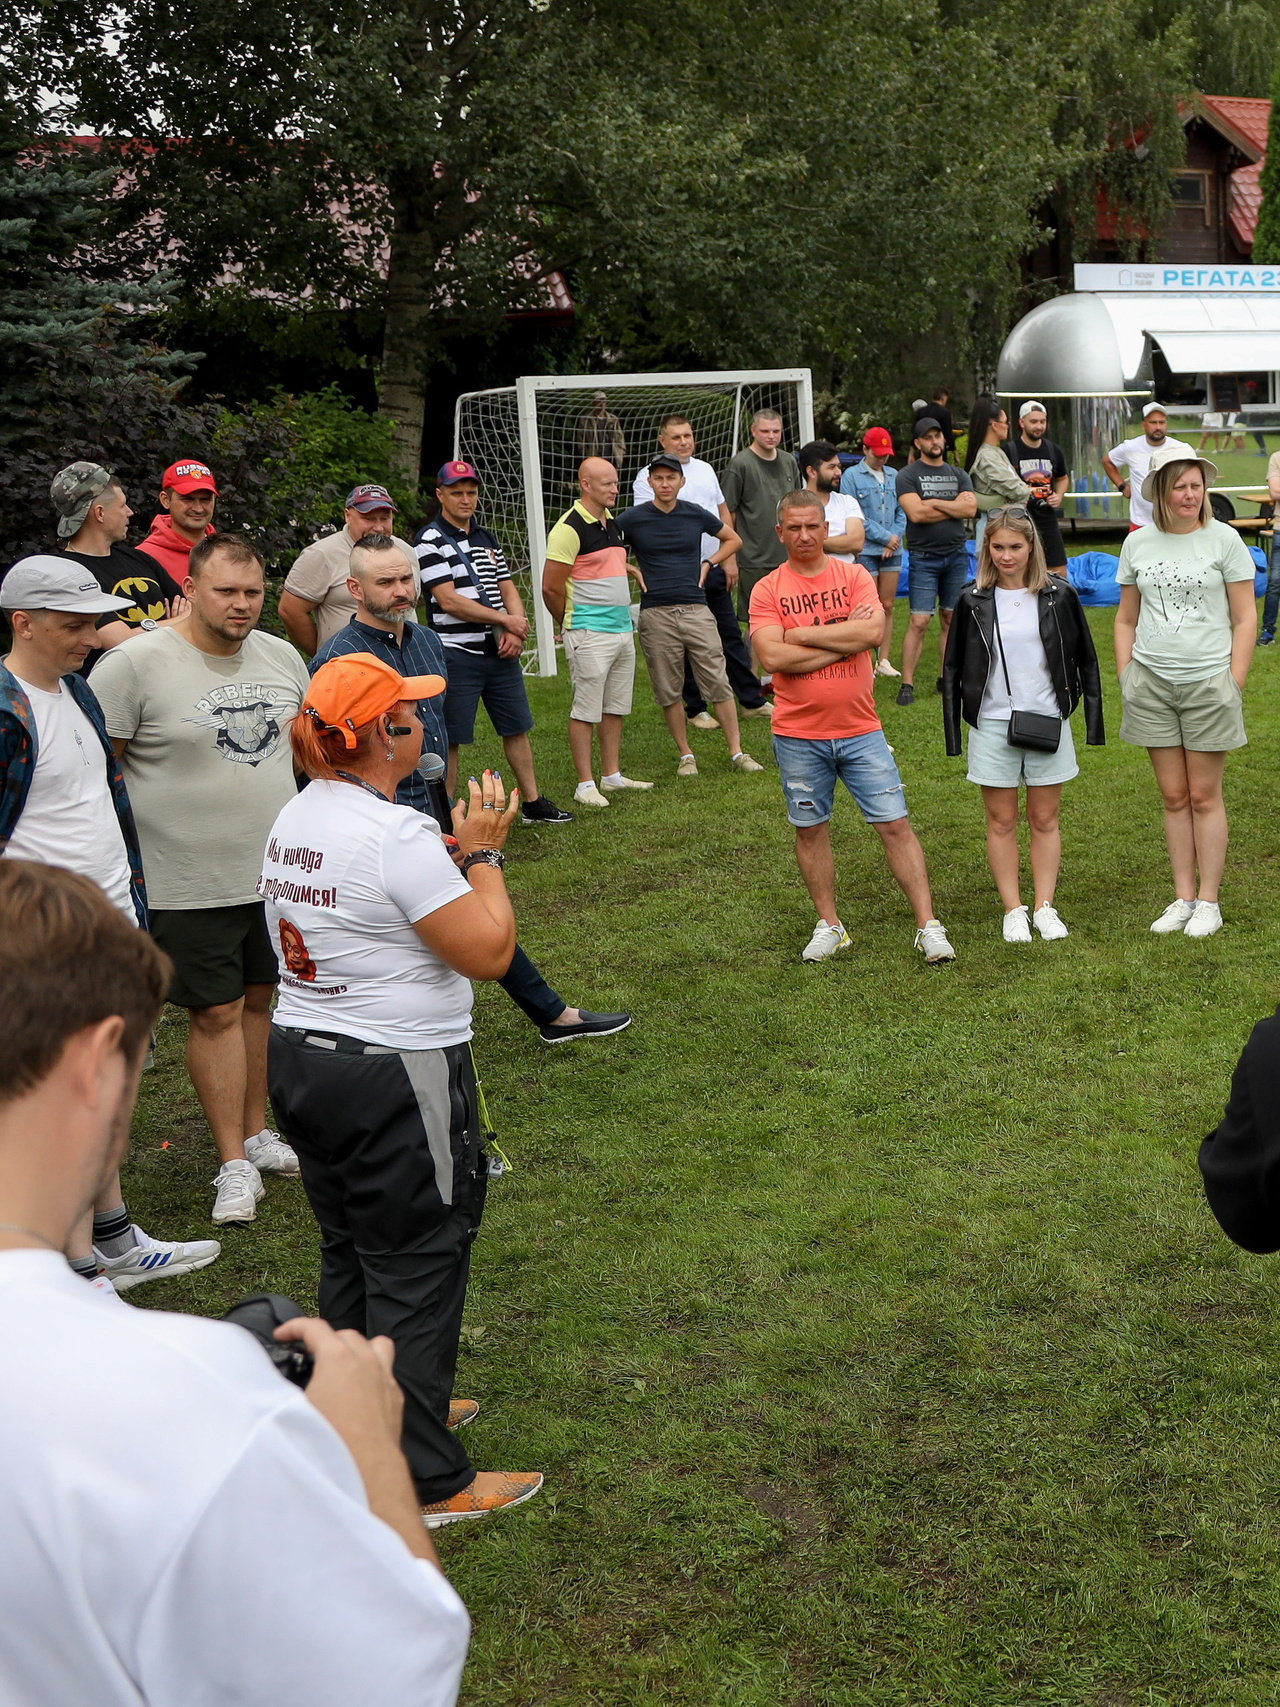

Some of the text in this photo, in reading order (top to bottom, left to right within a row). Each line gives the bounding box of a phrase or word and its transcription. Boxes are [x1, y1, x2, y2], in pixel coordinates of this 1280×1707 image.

[780, 586, 850, 616] SURFERS
[195, 682, 279, 716] REBELS
[266, 837, 325, 874] Мы никуда
